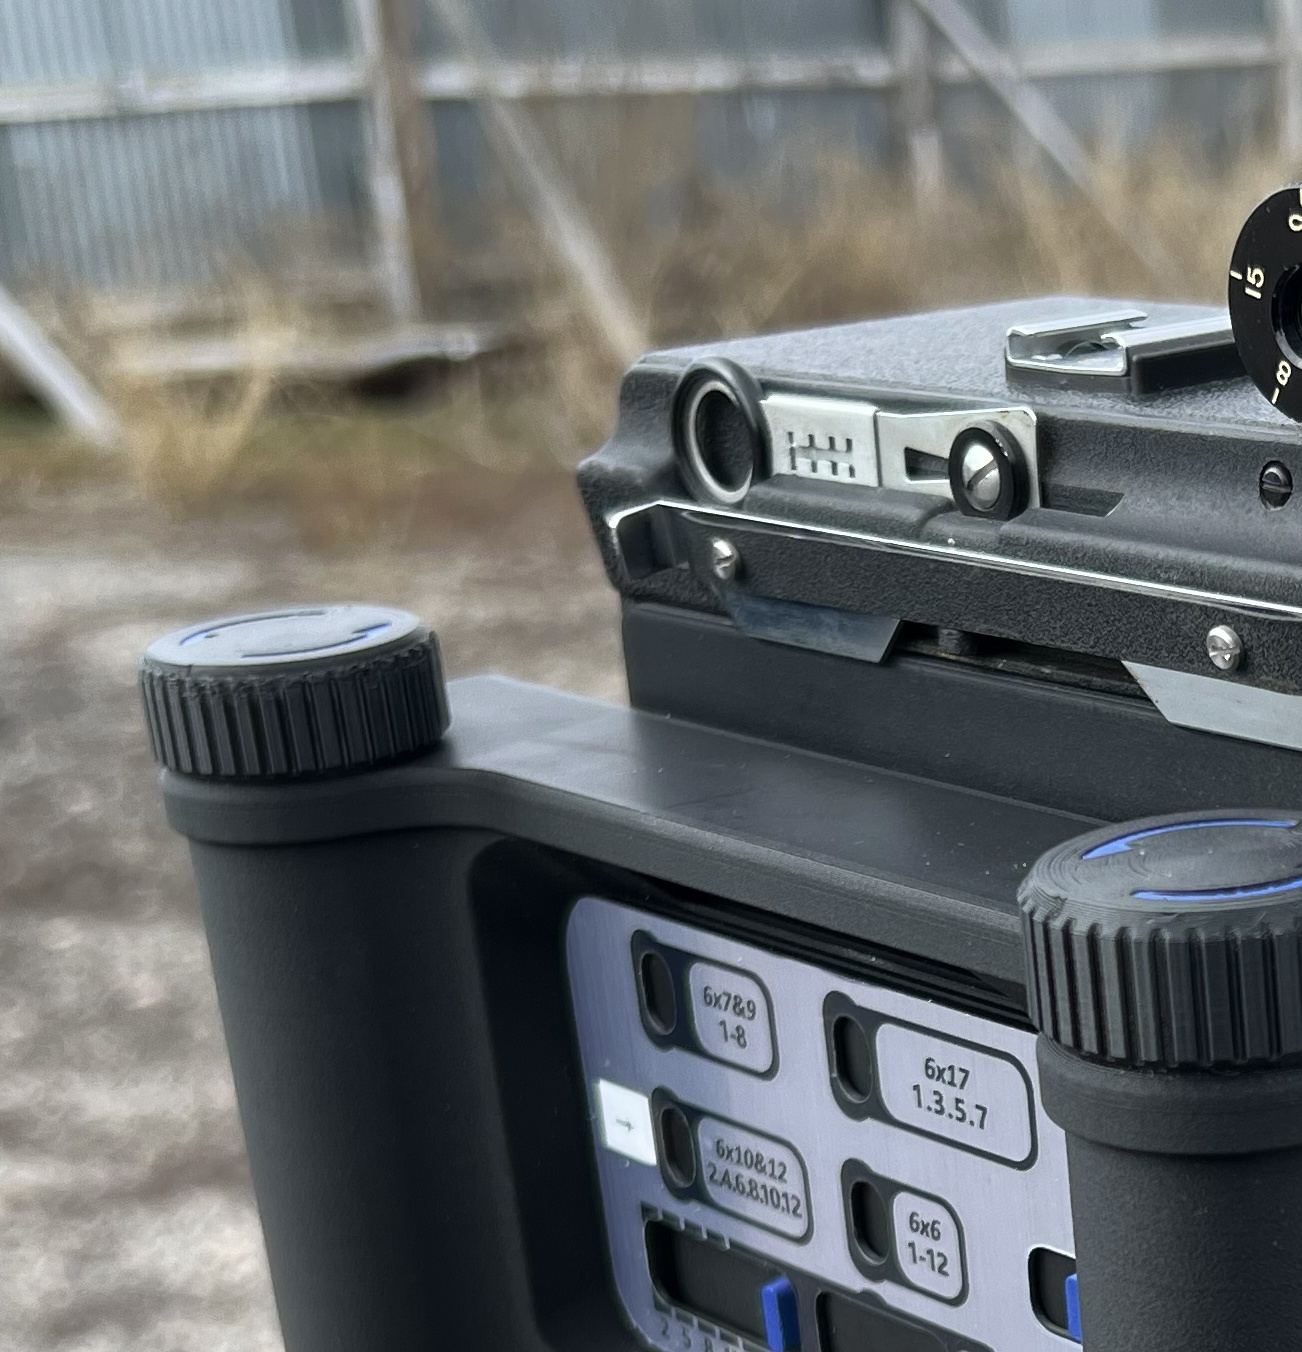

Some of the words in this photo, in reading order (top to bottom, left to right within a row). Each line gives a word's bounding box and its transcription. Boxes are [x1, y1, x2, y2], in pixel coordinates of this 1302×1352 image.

[1244, 266, 1265, 300] 15
[1275, 360, 1292, 386] 8
[703, 985, 757, 1021] 6x7&9
[718, 1018, 748, 1050] 1-8
[924, 1056, 971, 1090] 6x17
[912, 1083, 988, 1130] 1.3.5.7
[715, 1138, 788, 1184] 6x10&12
[908, 1210, 942, 1241] 6x6
[907, 1240, 950, 1278] 1-12
[660, 1317, 671, 1341] 2
[681, 1325, 692, 1349] 5
